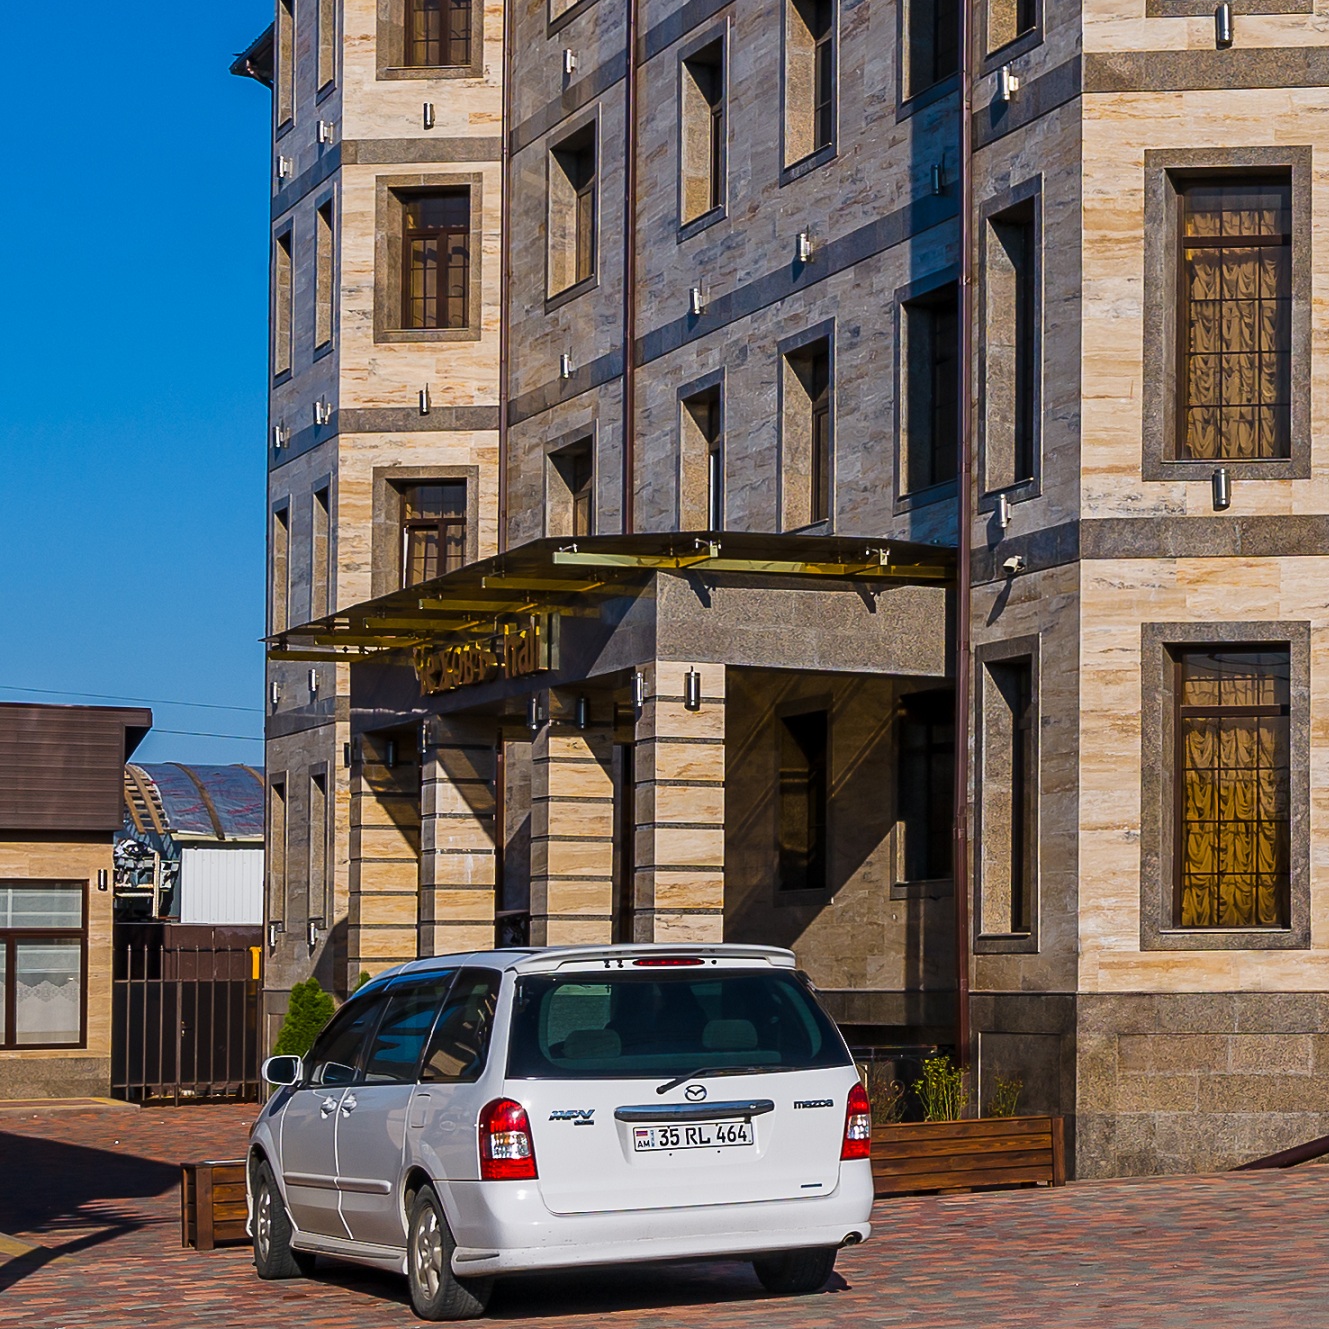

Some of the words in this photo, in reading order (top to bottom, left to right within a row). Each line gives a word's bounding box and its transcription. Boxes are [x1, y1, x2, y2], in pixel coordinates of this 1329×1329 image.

[659, 1128, 680, 1147] 35
[686, 1127, 711, 1145] RL
[716, 1124, 748, 1143] 464
